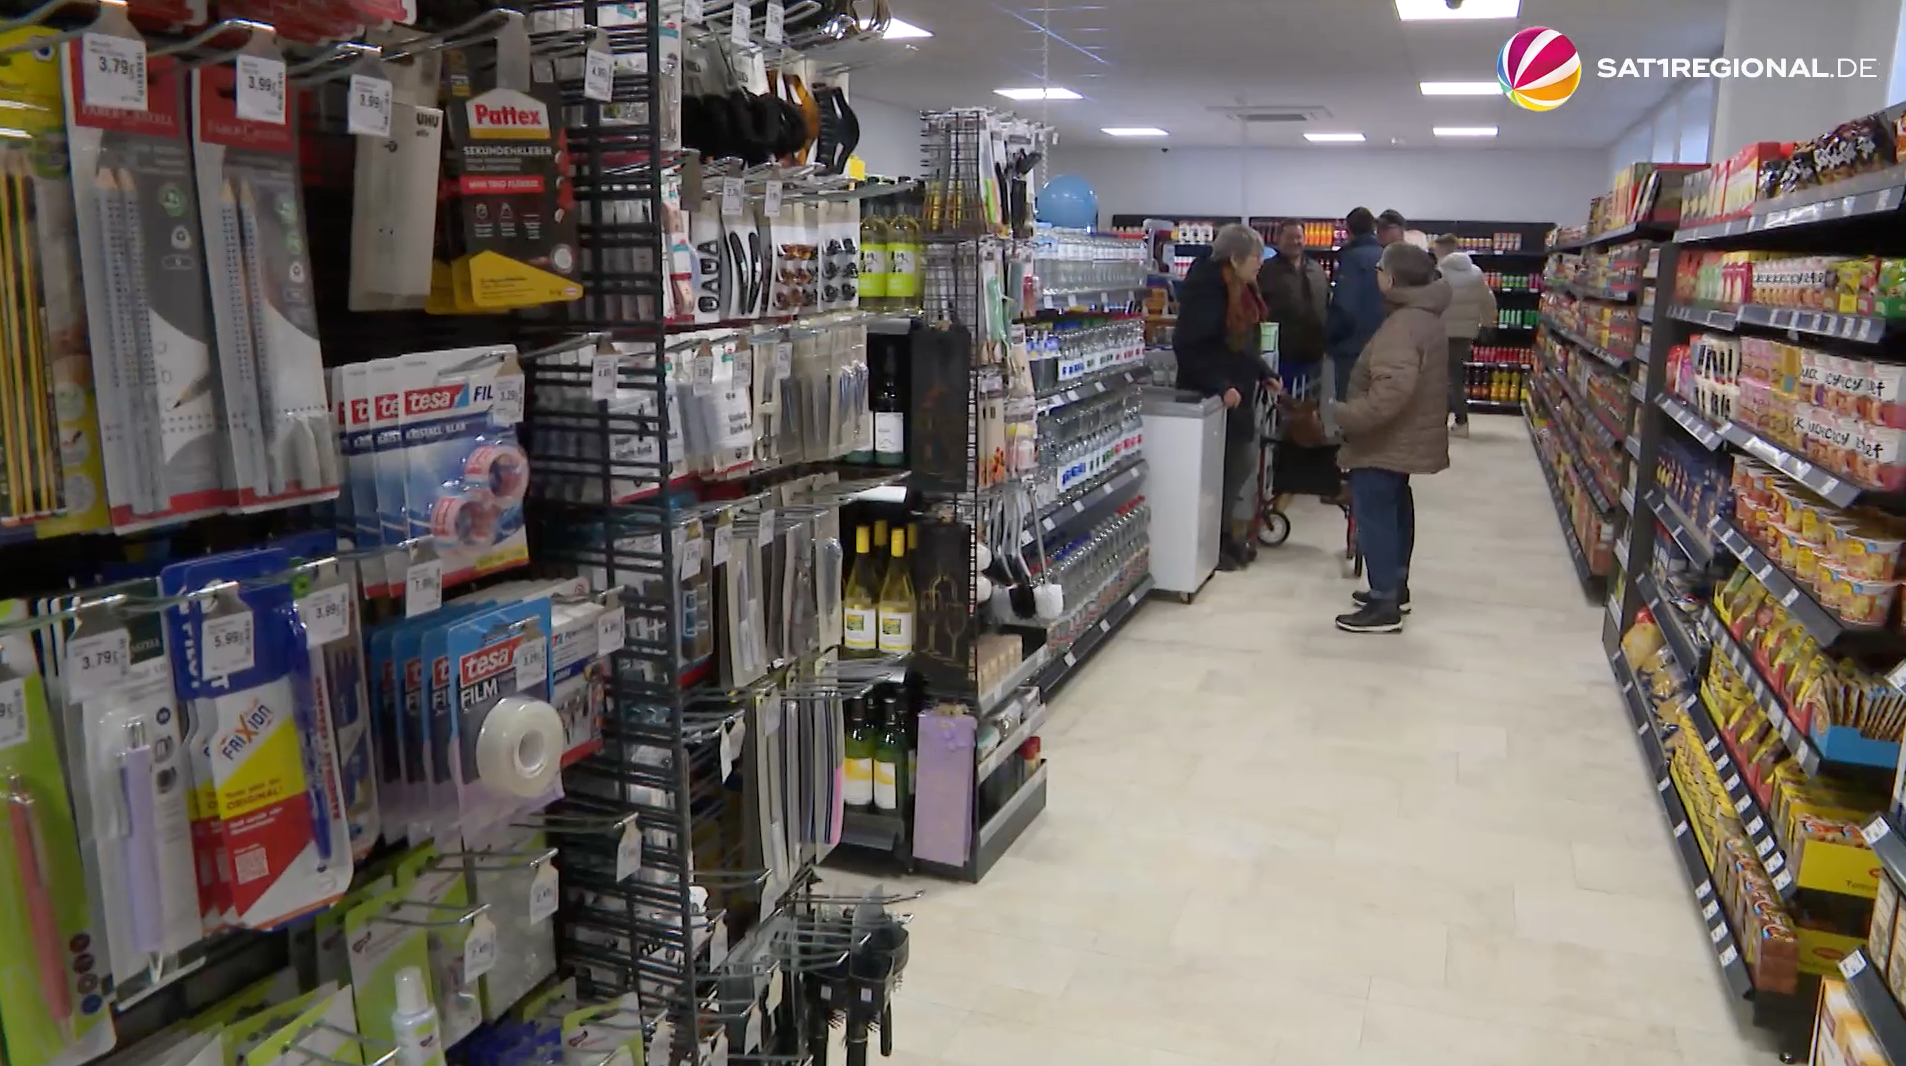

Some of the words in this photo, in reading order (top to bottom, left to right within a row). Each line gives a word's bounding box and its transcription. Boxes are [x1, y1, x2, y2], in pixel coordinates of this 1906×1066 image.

[416, 112, 440, 129] UHU
[474, 104, 542, 126] Pattex
[408, 391, 451, 412] tesa
[473, 385, 494, 402] FIL
[465, 647, 509, 679] tesa
[460, 677, 498, 709] FILM
